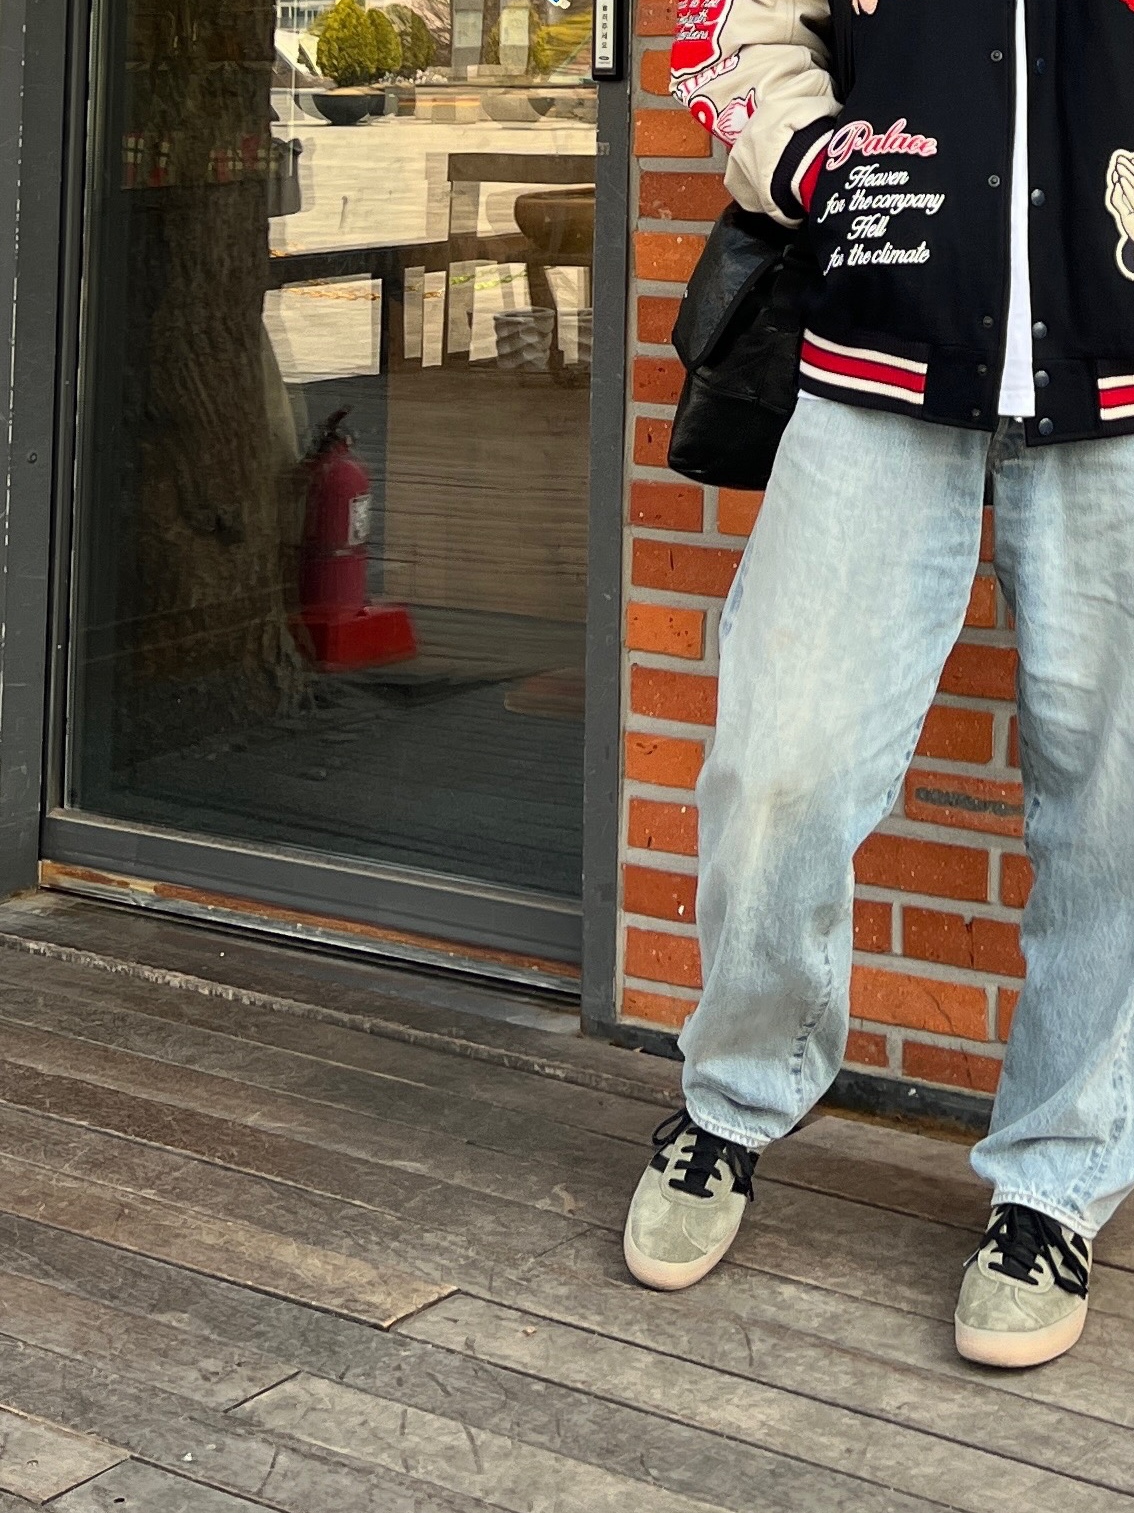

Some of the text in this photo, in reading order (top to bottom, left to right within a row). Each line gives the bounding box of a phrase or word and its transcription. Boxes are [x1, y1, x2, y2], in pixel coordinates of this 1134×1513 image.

[826, 118, 938, 171] Palace
[845, 163, 910, 190] Heaven
[817, 192, 846, 224] for
[846, 213, 890, 240] Hell
